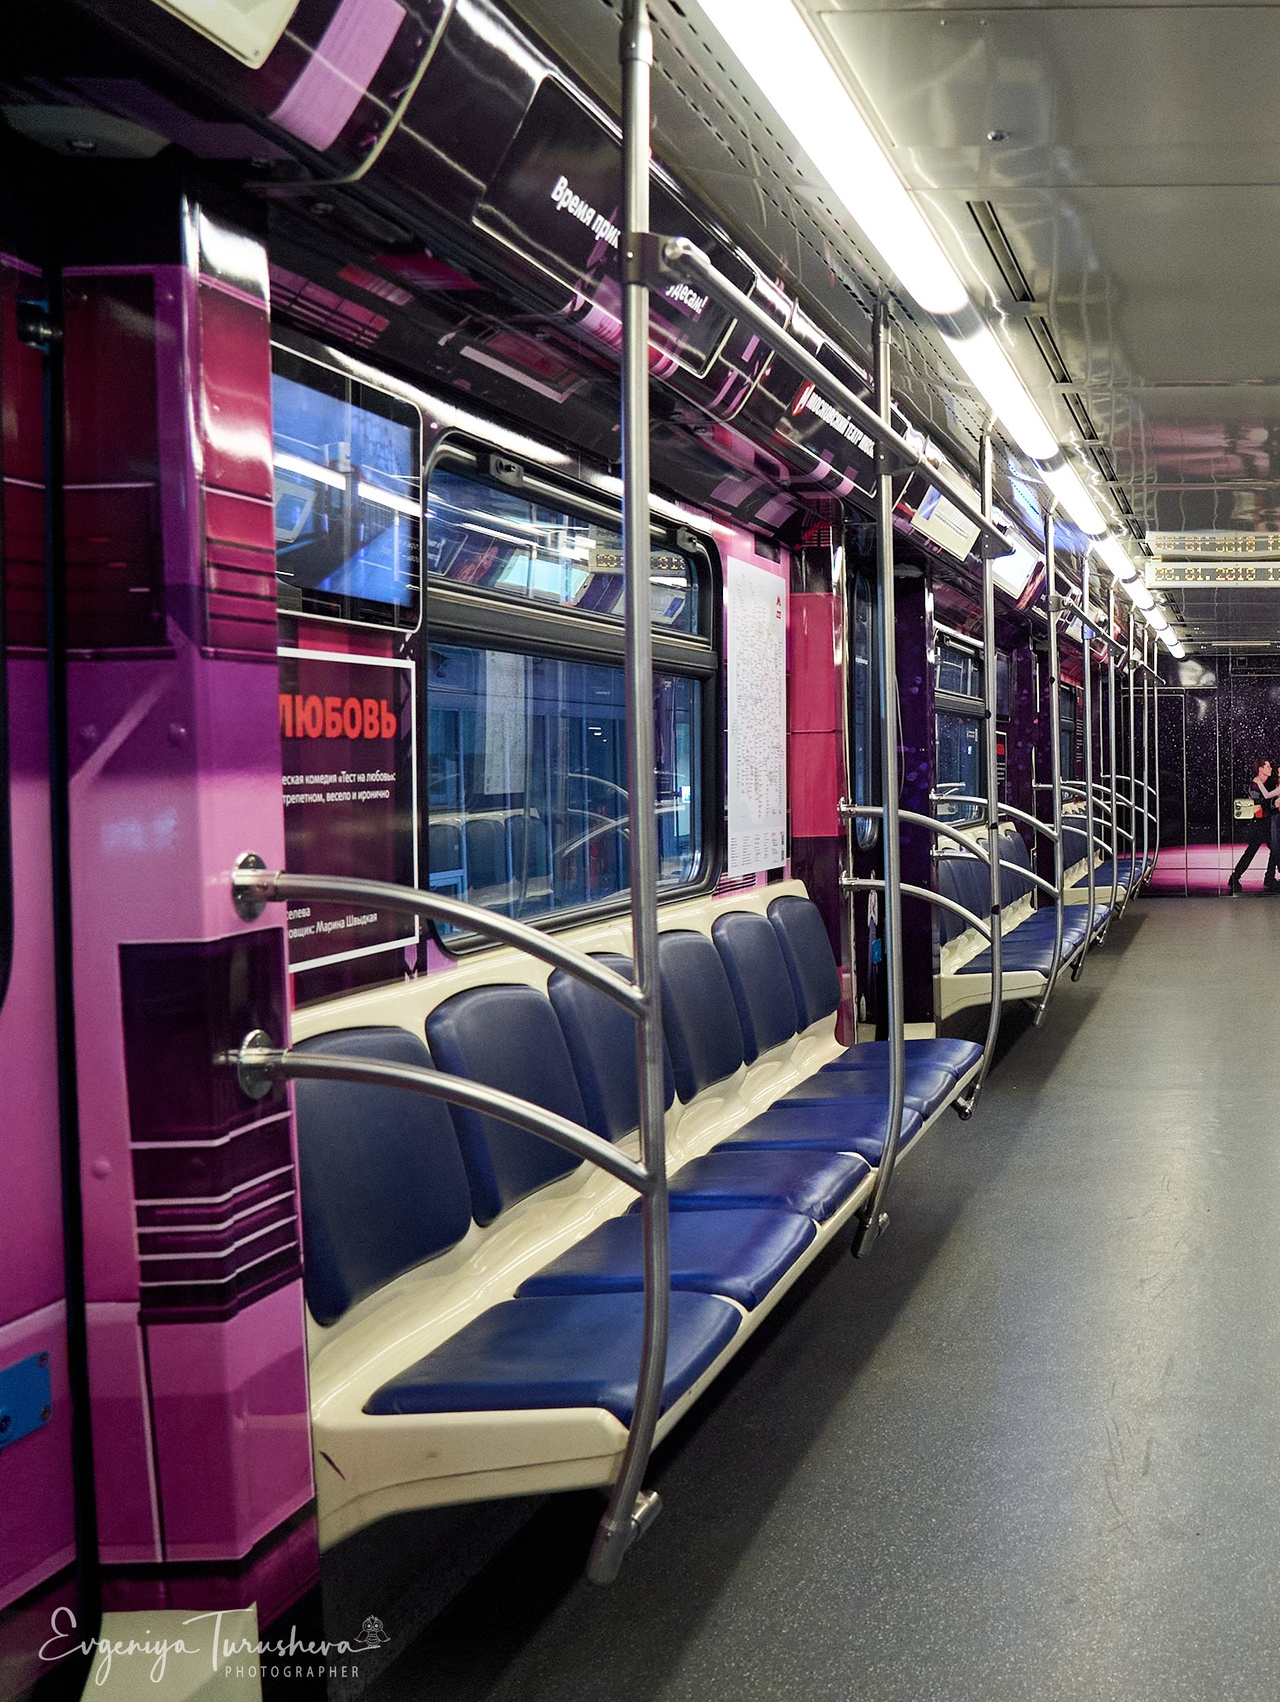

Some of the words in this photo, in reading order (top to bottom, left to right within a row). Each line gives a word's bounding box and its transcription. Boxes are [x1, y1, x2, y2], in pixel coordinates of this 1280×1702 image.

[551, 175, 596, 227] Время
[665, 283, 709, 314] удесам!
[278, 694, 397, 739] ЛЮБОВЬ
[305, 773, 337, 786] комедия
[338, 770, 357, 783] «Тест
[357, 772, 366, 782] на
[326, 792, 351, 802] весело
[357, 790, 390, 802] иронично
[286, 907, 311, 920] елева
[316, 920, 345, 934] Марина
[346, 912, 377, 928] Швыдкая
